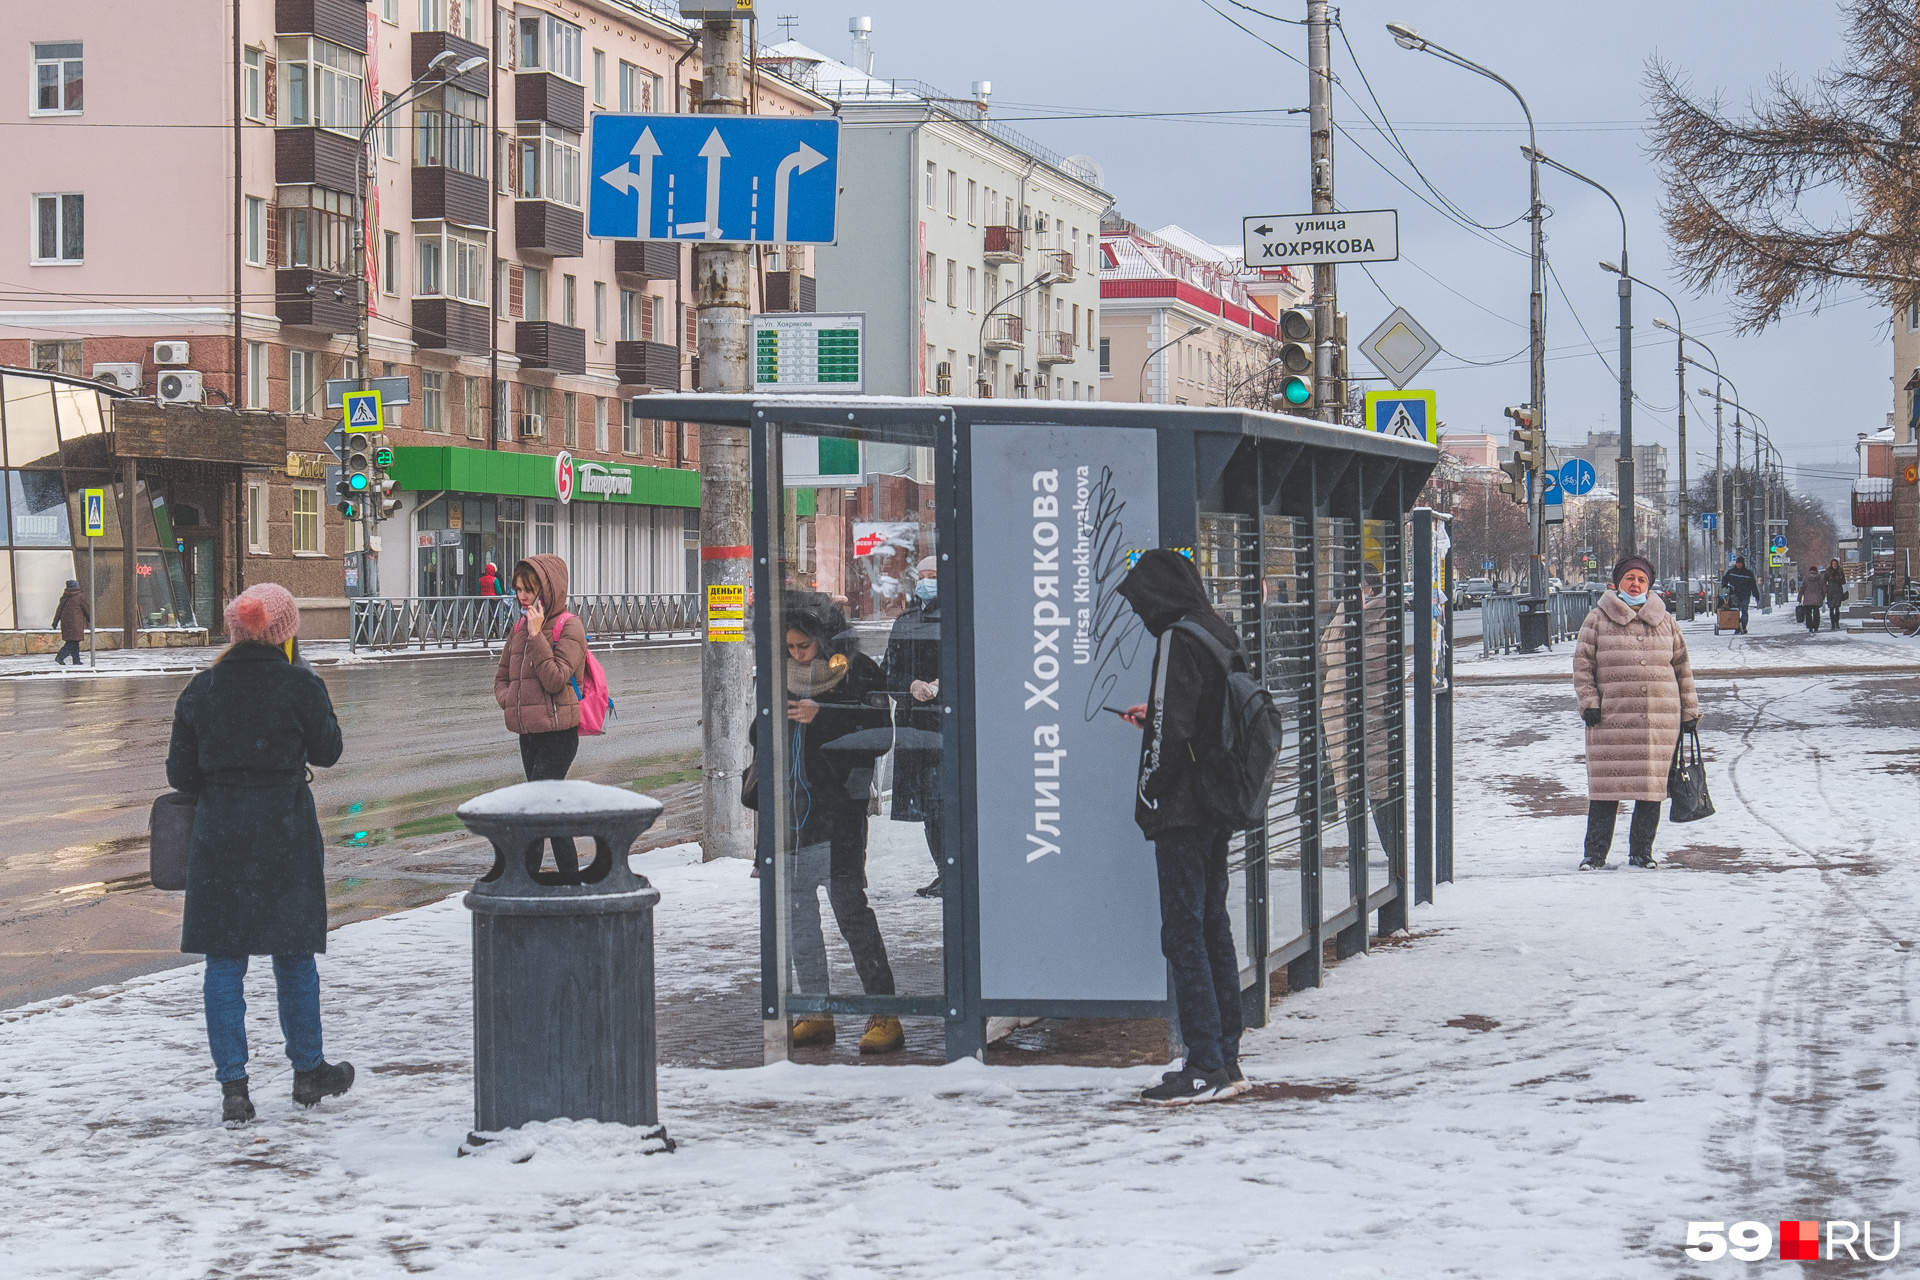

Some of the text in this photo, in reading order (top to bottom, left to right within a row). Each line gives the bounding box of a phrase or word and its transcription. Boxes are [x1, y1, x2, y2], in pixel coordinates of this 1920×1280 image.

[1295, 220, 1346, 235] улица
[1262, 238, 1375, 258] ХОХРЯКОВА
[299, 454, 327, 479] Хлеб
[377, 451, 392, 464] 23
[1072, 464, 1091, 665] Ulitsa Khokhryakova
[1025, 468, 1070, 864] Улица Хохрякова
